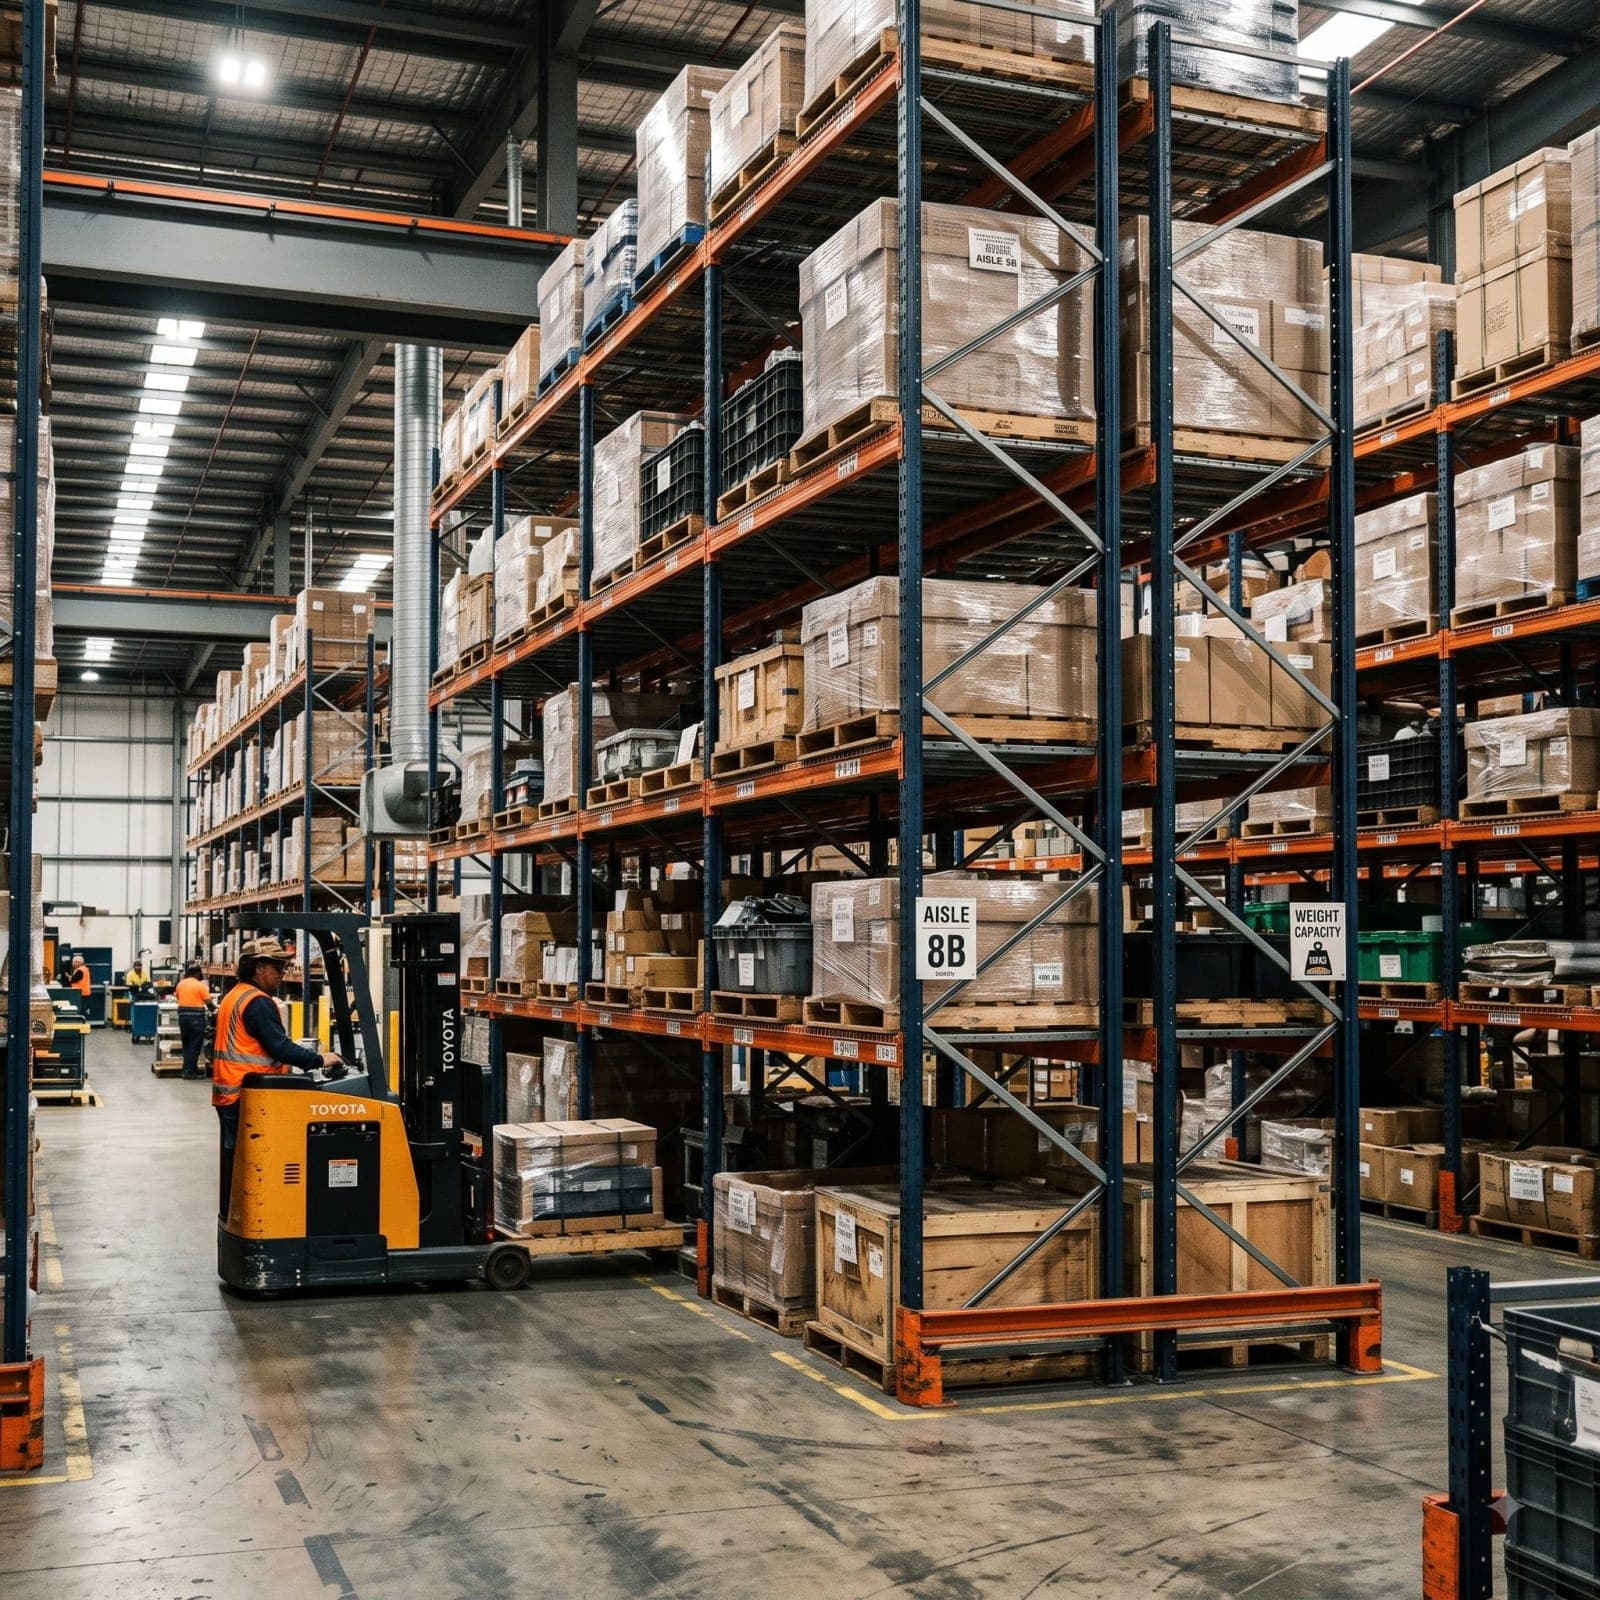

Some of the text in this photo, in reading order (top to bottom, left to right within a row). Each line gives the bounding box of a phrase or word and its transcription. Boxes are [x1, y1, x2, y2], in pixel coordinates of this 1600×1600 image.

[976, 254, 1003, 266] AISLE
[923, 905, 970, 923] AISLE
[1295, 909, 1340, 923] WEIGHT
[1294, 926, 1341, 938] CAPACITY
[927, 934, 966, 968] 8B
[442, 1008, 455, 1072] TOYOTA
[309, 1103, 367, 1116] TOYOTA
